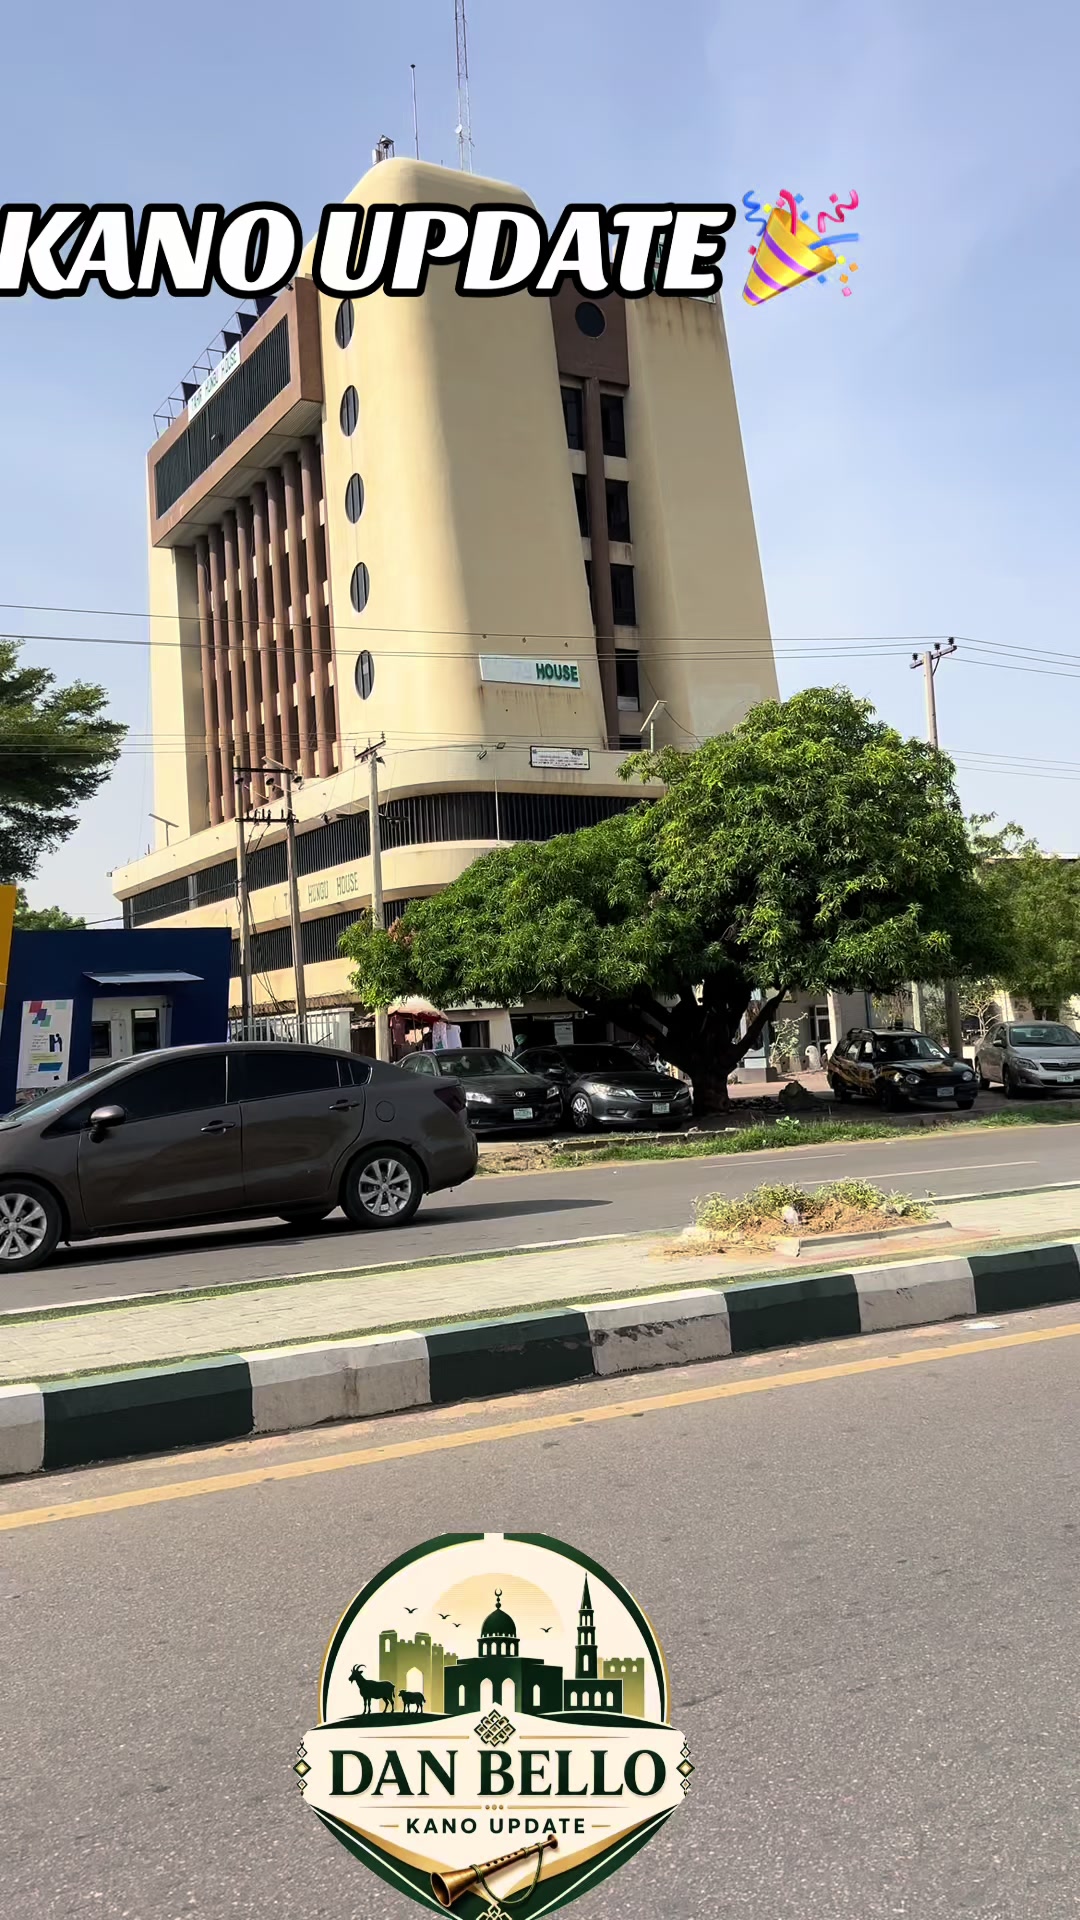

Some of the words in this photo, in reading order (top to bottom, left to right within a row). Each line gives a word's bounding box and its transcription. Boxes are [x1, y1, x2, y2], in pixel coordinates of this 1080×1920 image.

[221, 347, 237, 378] HOUSE
[535, 662, 579, 684] HOUSE
[336, 871, 359, 897] HOUSE
